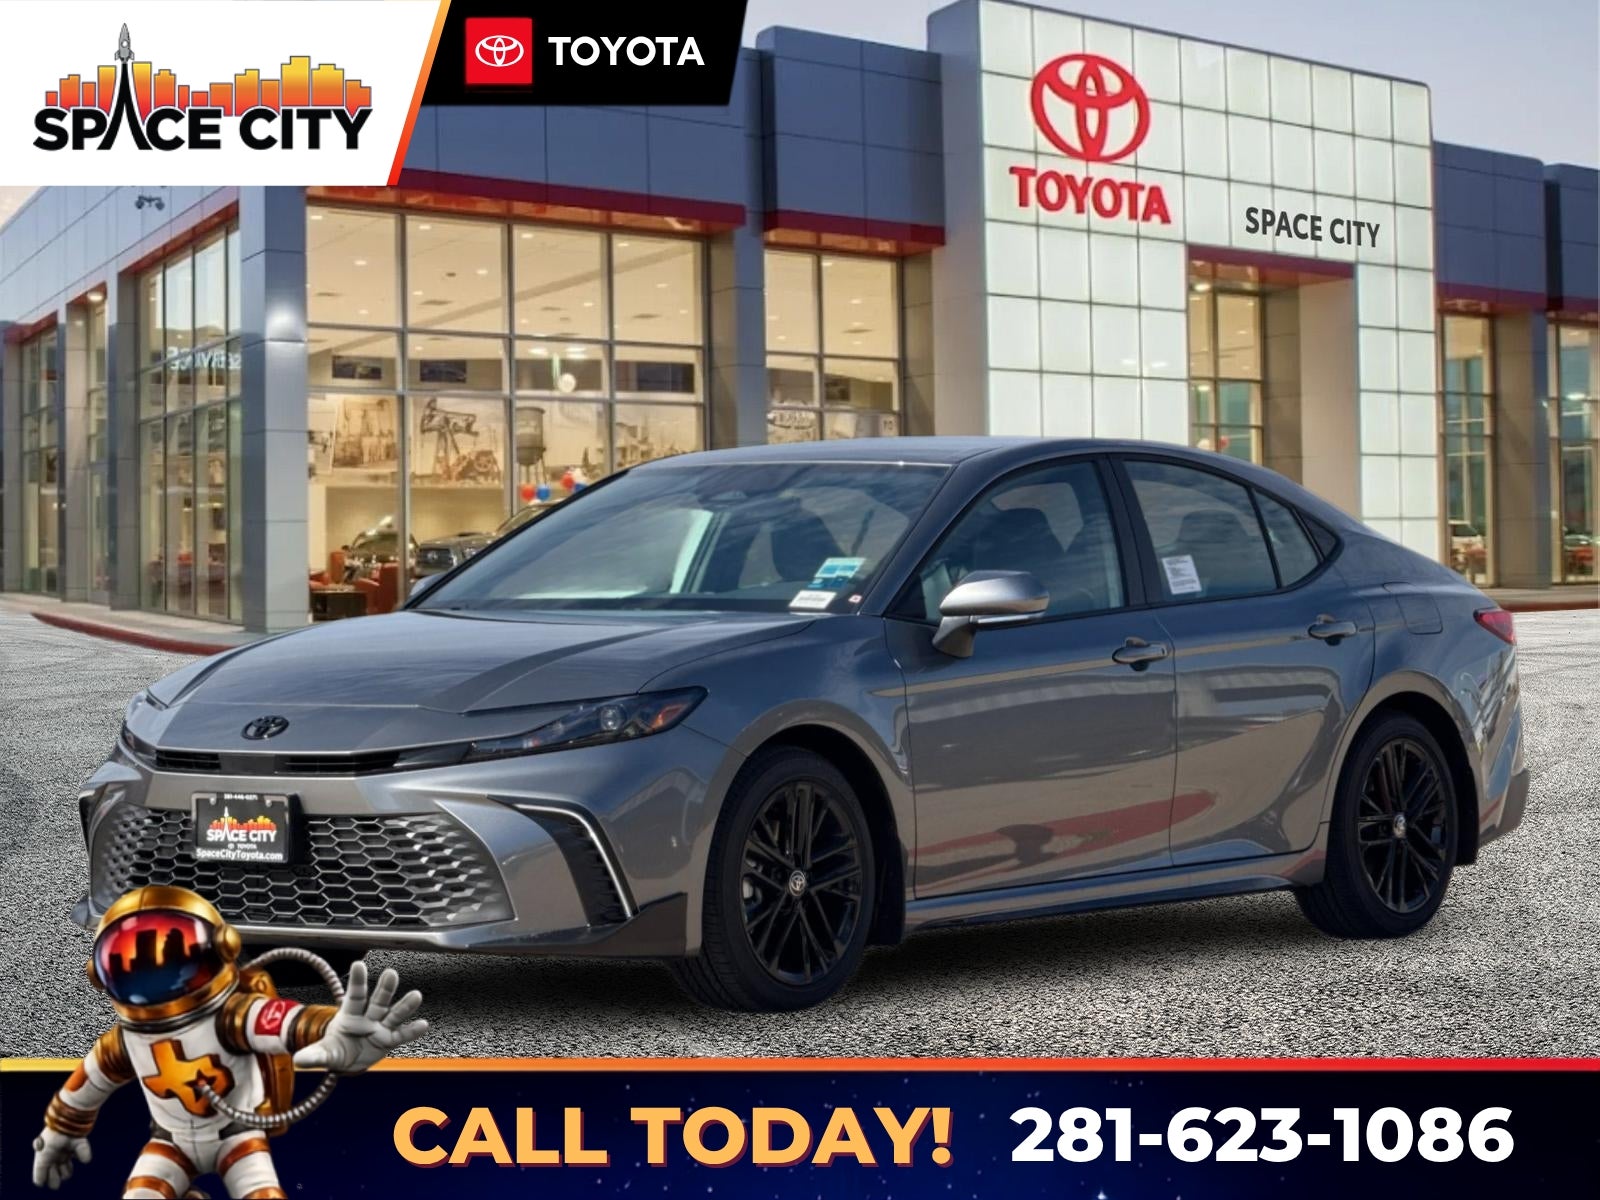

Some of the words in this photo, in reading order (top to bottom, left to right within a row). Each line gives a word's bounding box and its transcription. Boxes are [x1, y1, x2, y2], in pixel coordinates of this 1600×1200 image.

[1009, 166, 1171, 225] TOYOTA
[1245, 206, 1323, 242] SPACE
[1329, 217, 1381, 249] CITY
[206, 829, 247, 842] SPACE
[249, 830, 277, 842] CITY
[196, 848, 283, 861] SpaceCityToyota.com
